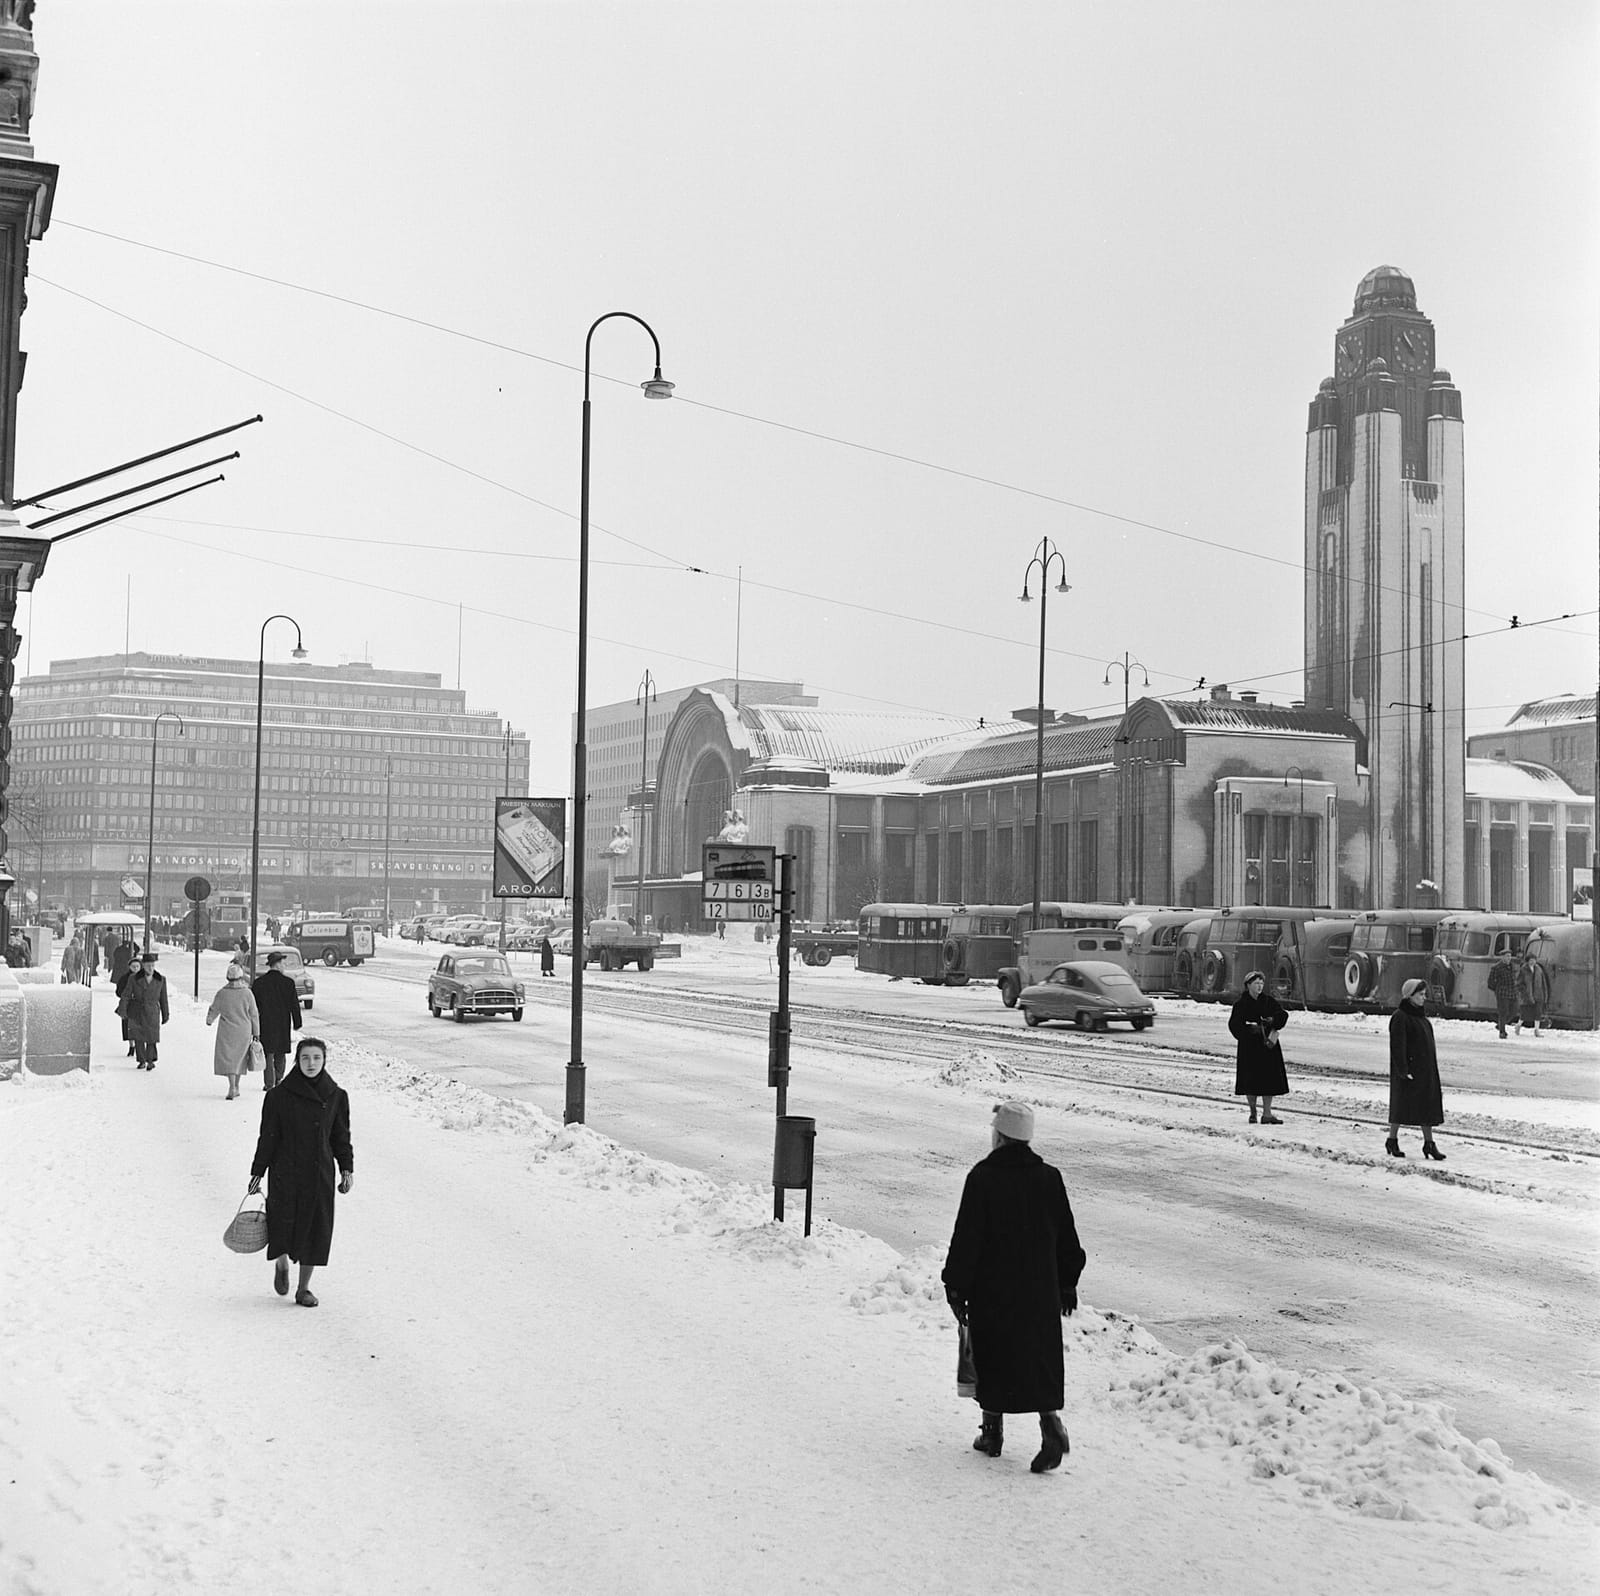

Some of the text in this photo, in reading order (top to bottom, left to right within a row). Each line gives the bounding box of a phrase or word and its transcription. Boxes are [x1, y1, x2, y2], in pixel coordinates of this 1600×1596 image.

[291, 838, 351, 849] SOKOS
[498, 884, 558, 894] AROMA
[712, 882, 720, 897] 7
[735, 884, 743, 898] 6
[709, 903, 770, 918] 12 10A
[644, 914, 653, 925] P
